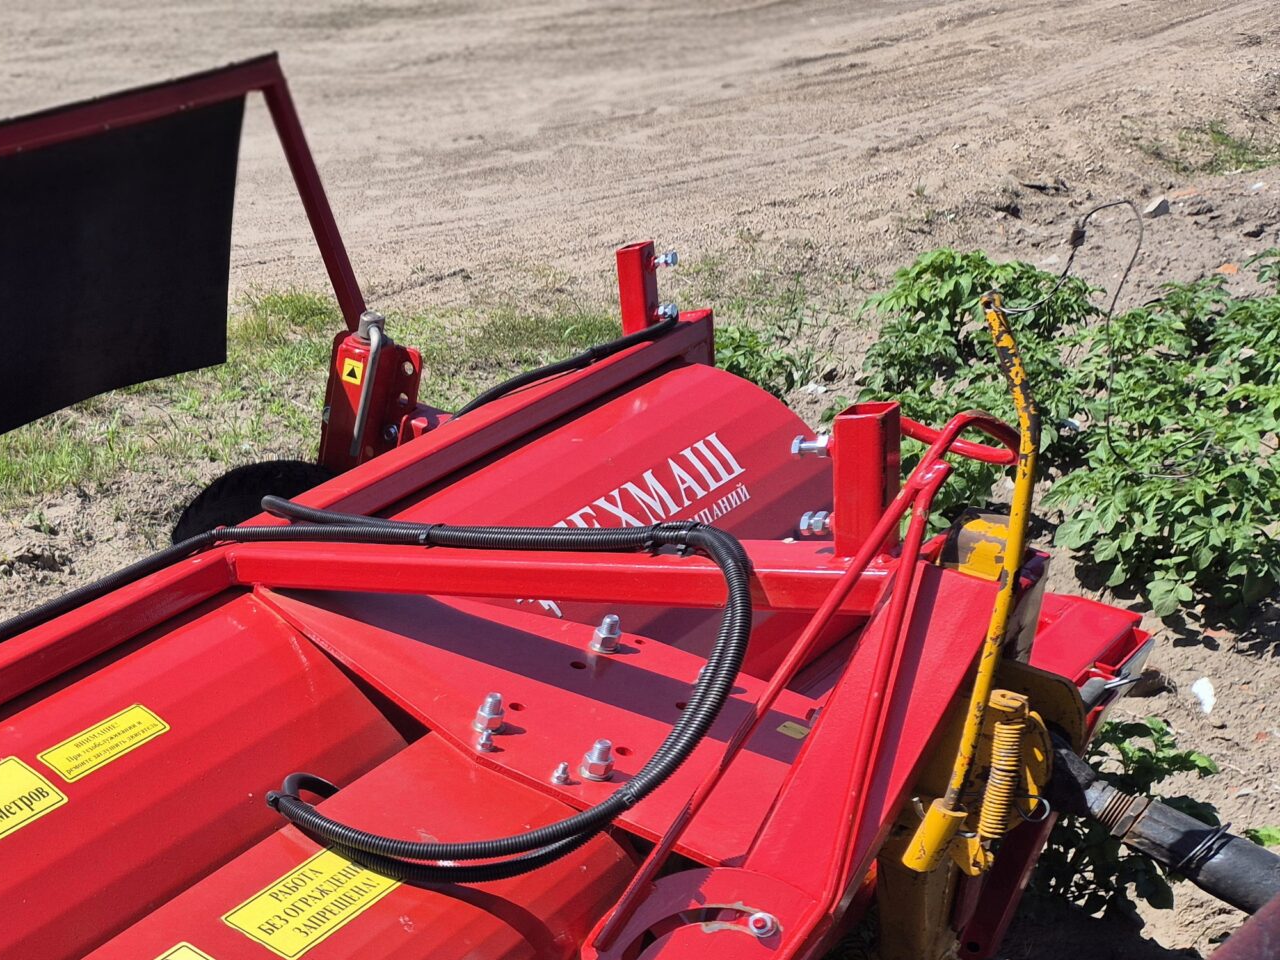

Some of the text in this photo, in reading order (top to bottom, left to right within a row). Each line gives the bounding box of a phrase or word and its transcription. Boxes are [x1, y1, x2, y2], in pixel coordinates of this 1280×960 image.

[257, 864, 366, 936] БЕЗ ОГРАЖДЕНИ
[268, 867, 324, 903] РАБОТА
[292, 877, 381, 937] ЗАПРЕЩЕНА!
